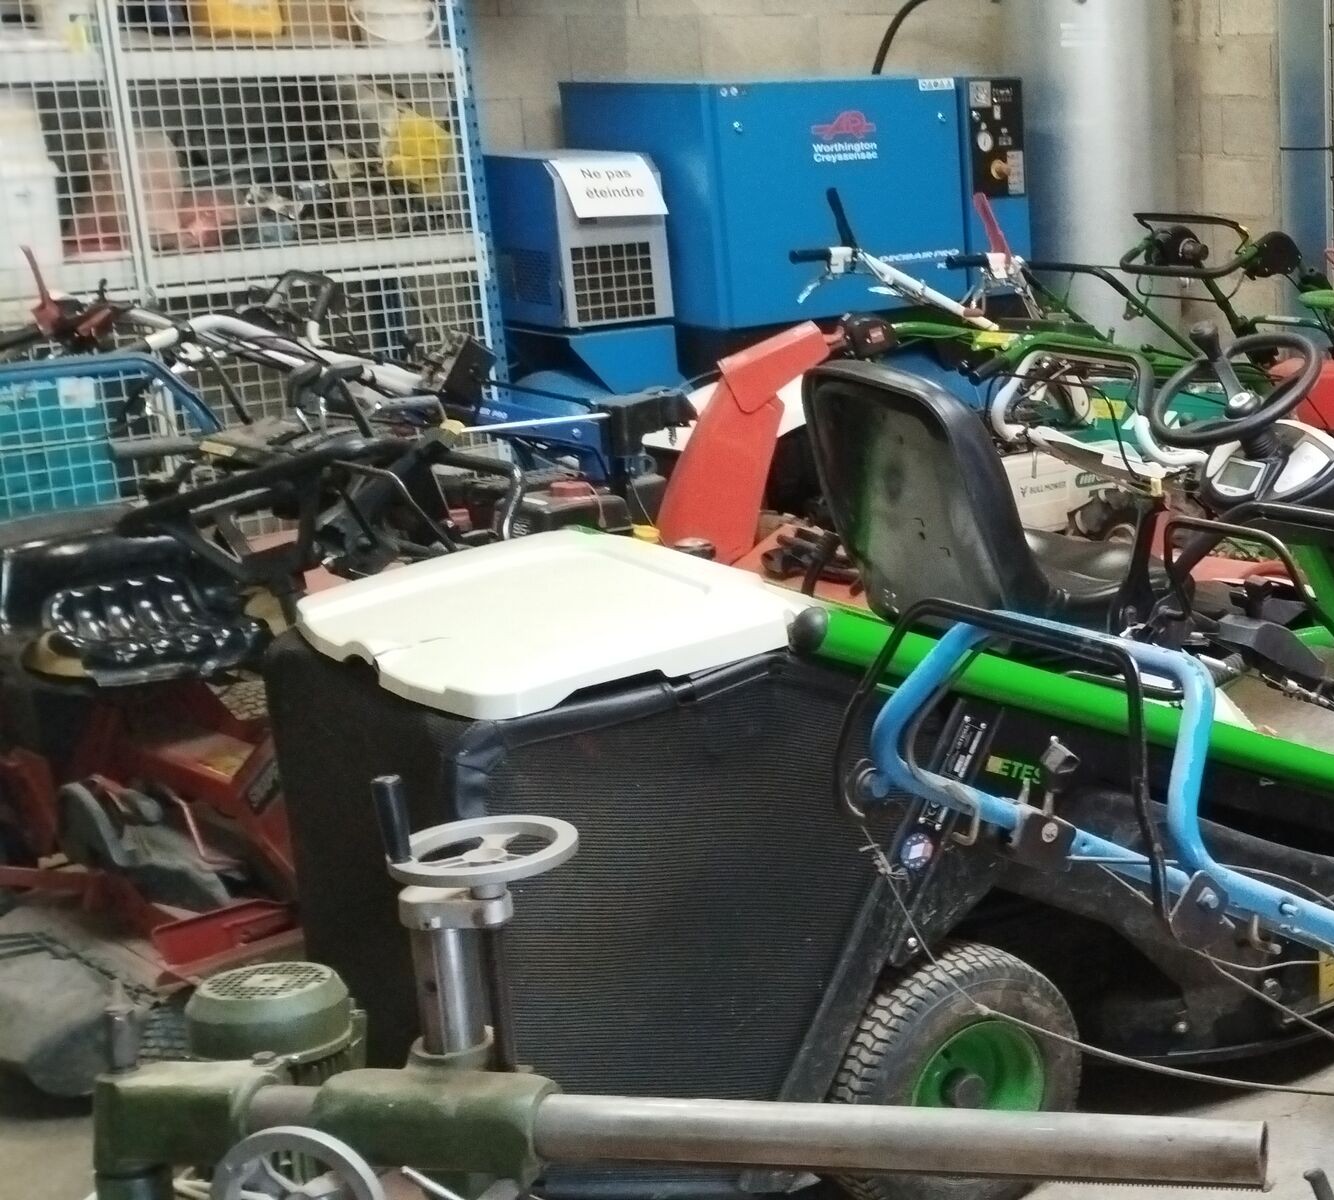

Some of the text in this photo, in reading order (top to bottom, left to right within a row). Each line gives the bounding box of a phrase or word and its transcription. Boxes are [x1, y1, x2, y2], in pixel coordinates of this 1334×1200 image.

[812, 142, 878, 153] Worthington
[813, 151, 879, 163] Creyssensac
[580, 168, 632, 182] Ne pas
[999, 758, 1042, 786] ETES
